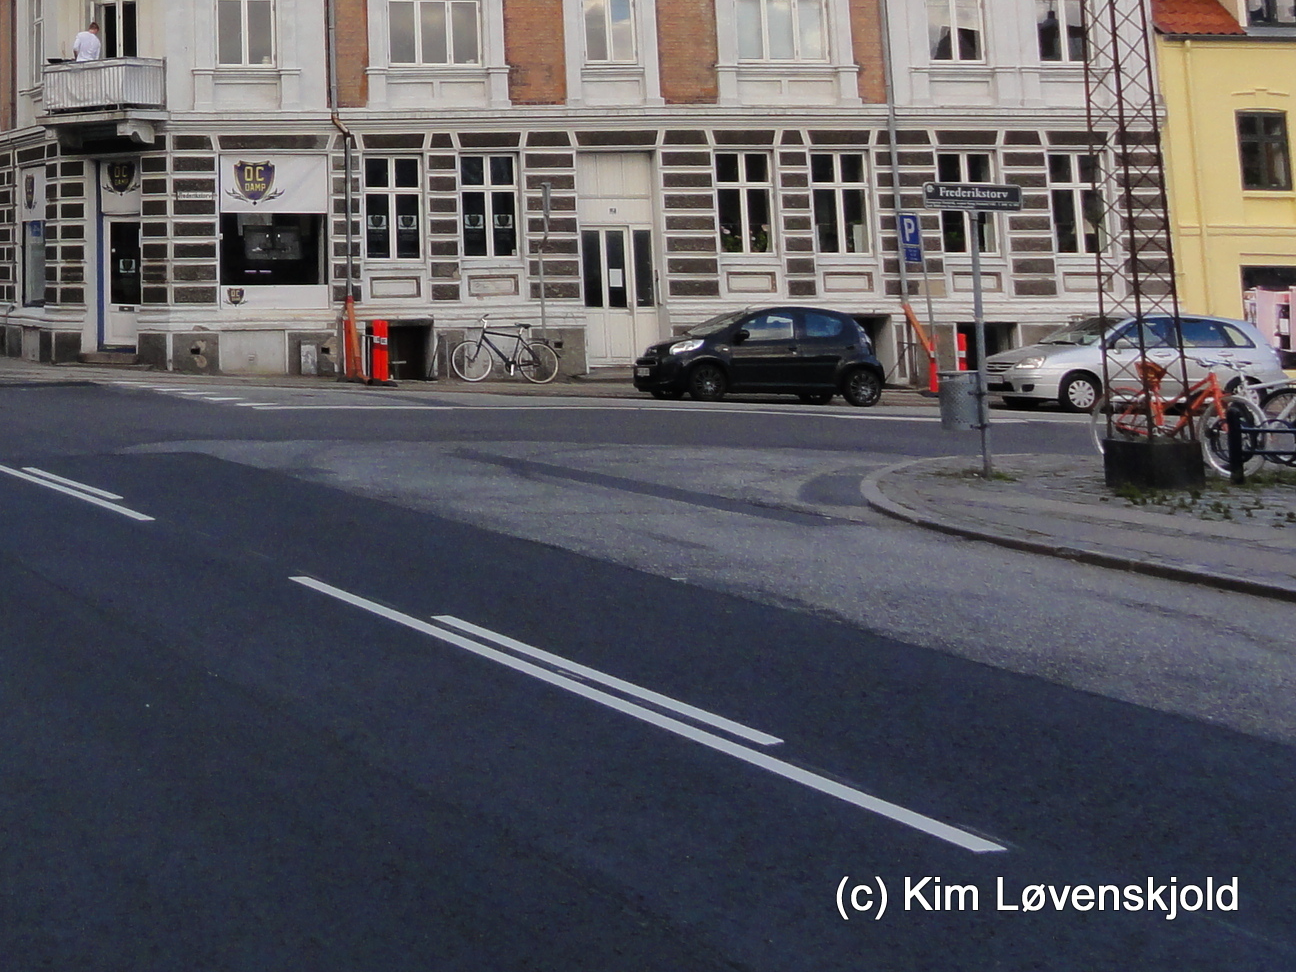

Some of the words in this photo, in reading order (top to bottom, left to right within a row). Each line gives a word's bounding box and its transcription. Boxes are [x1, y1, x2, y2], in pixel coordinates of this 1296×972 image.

[114, 166, 128, 178] OC
[244, 166, 264, 181] OC
[245, 183, 266, 192] DAMP
[939, 186, 1008, 198] Frederikstorv
[904, 218, 915, 242] P
